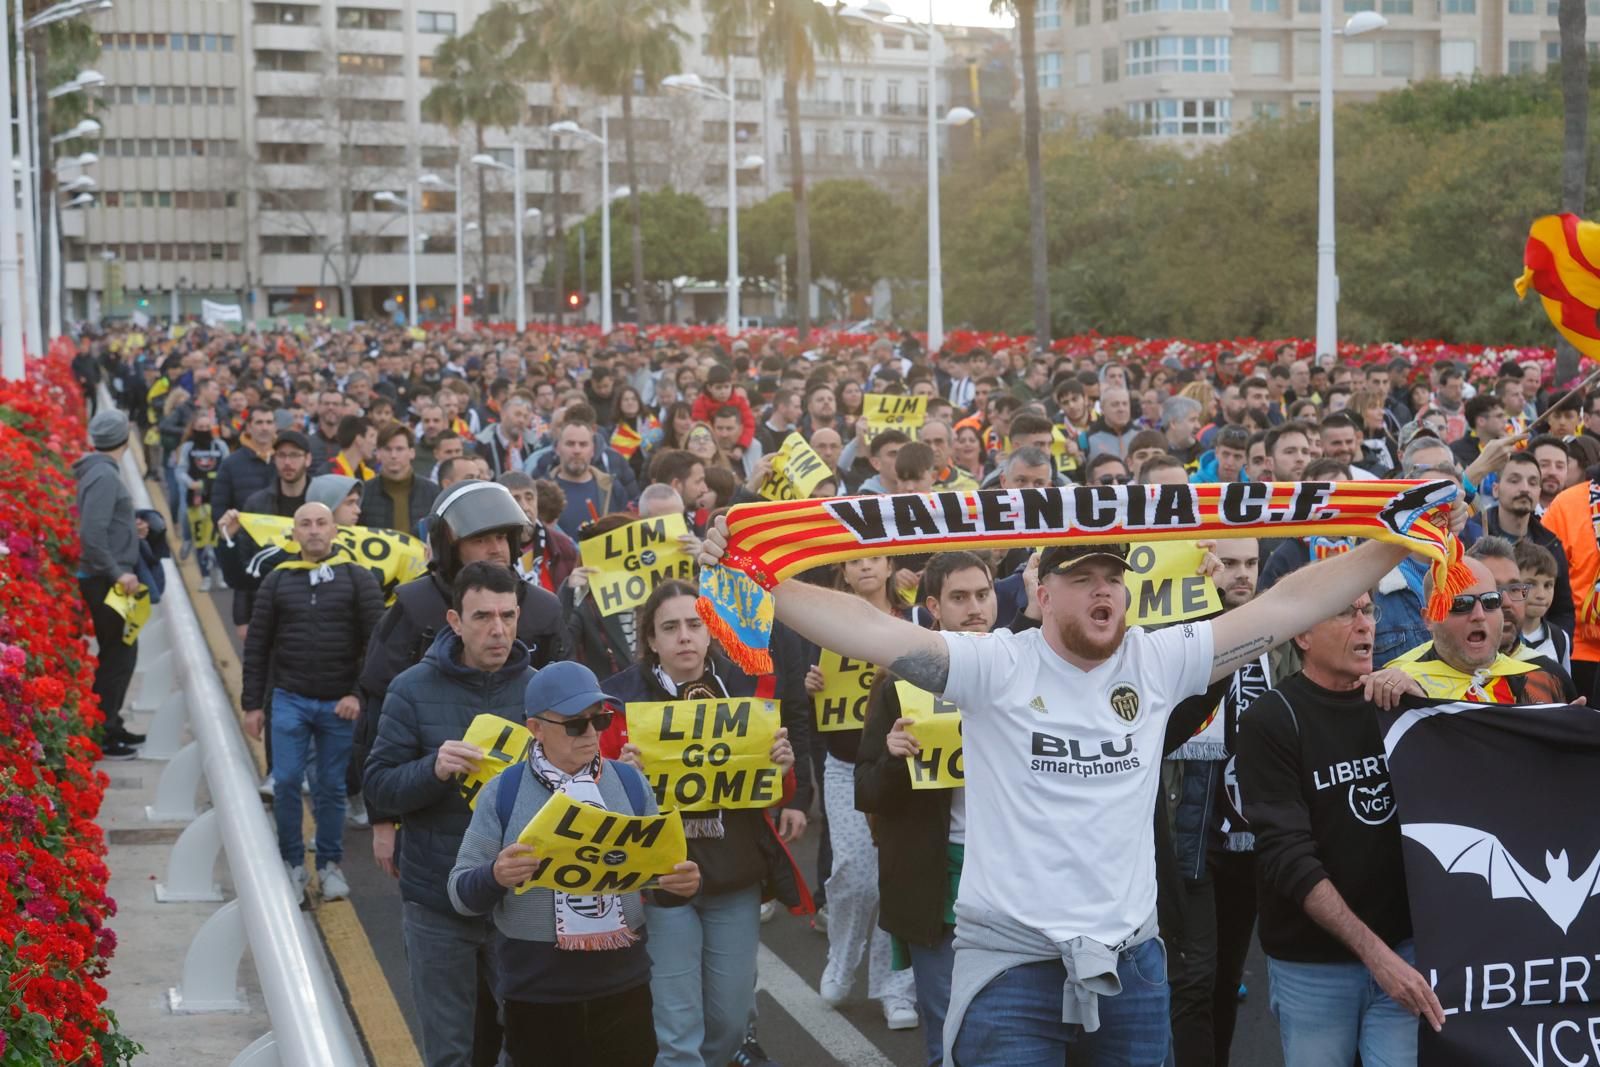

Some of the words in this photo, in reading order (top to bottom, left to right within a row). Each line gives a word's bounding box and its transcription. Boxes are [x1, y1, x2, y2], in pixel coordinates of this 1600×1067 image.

[878, 397, 919, 413] LIM
[830, 483, 1197, 540] VALENCIA
[1223, 482, 1335, 523] C.F.
[605, 518, 666, 560] LIM
[659, 702, 751, 741] LIM
[682, 742, 731, 768] GO
[1031, 731, 1133, 761] BLU
[1030, 757, 1140, 778] smartphones
[1313, 753, 1390, 791] LIBERT
[645, 768, 777, 806] HOME
[1360, 796, 1391, 814] VCF
[554, 804, 667, 848] LIM
[1430, 954, 1600, 1016] LIBER
